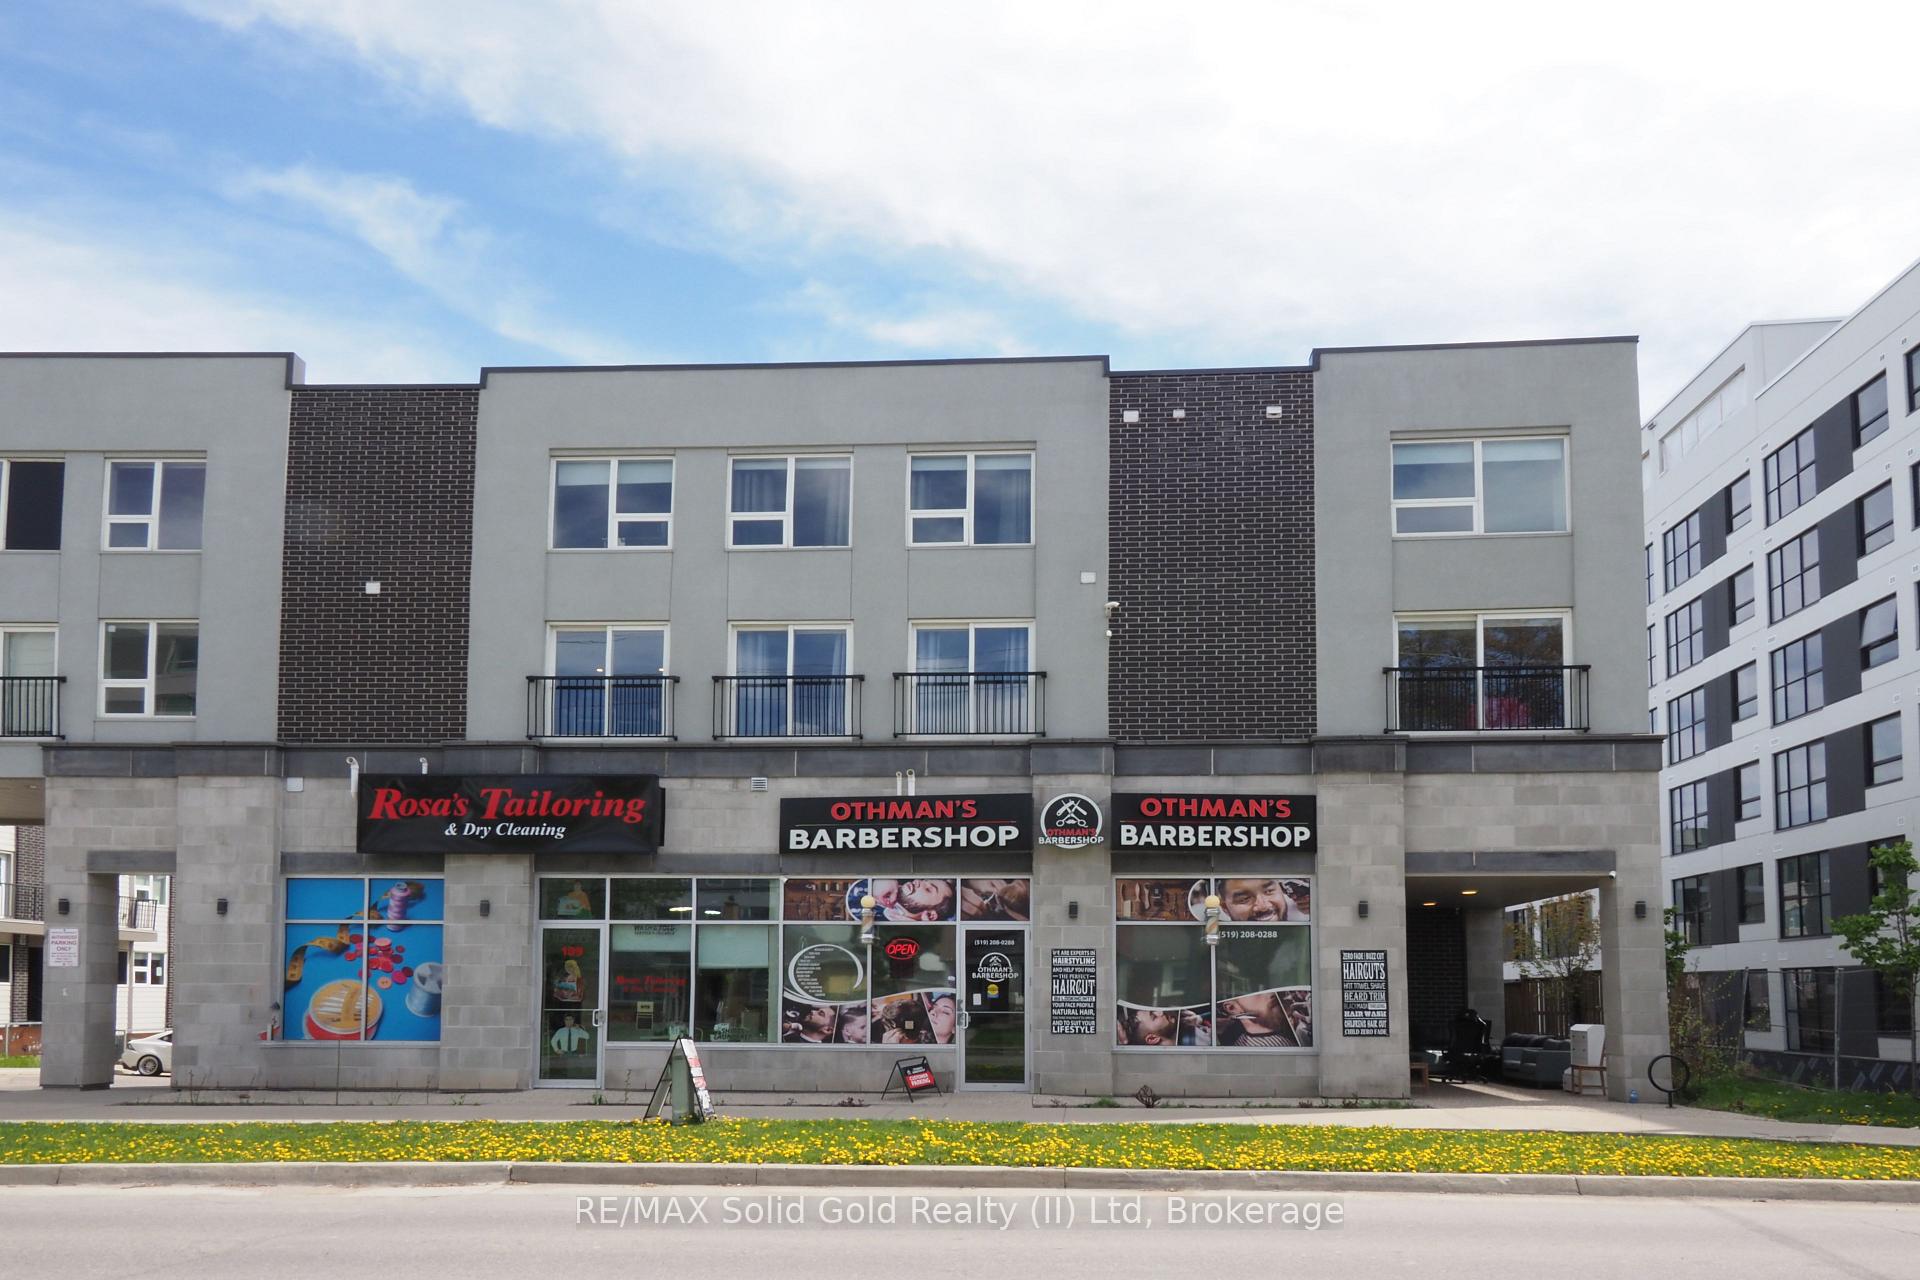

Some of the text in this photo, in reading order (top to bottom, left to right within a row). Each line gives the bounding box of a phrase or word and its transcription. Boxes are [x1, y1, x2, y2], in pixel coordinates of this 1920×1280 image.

[367, 788, 647, 824] Rosa's Tailoring
[830, 800, 977, 821] OTHMAN'S
[1140, 798, 1291, 818] OTHMAN'S
[444, 822, 567, 839] & Dry Cleaning
[789, 826, 1020, 850] BARBERSHOP
[1047, 828, 1096, 836] OTHMAN'S
[1120, 824, 1311, 847] BARBERSHOP
[1038, 836, 1104, 845] BARBERSHOP
[1218, 930, 1278, 939] (519) 208-0288
[887, 944, 916, 955] OPEN
[1343, 962, 1386, 980] HAIRCUTS
[1052, 979, 1095, 995] HAIRCUT
[1344, 992, 1386, 1001] BEARD TRIM
